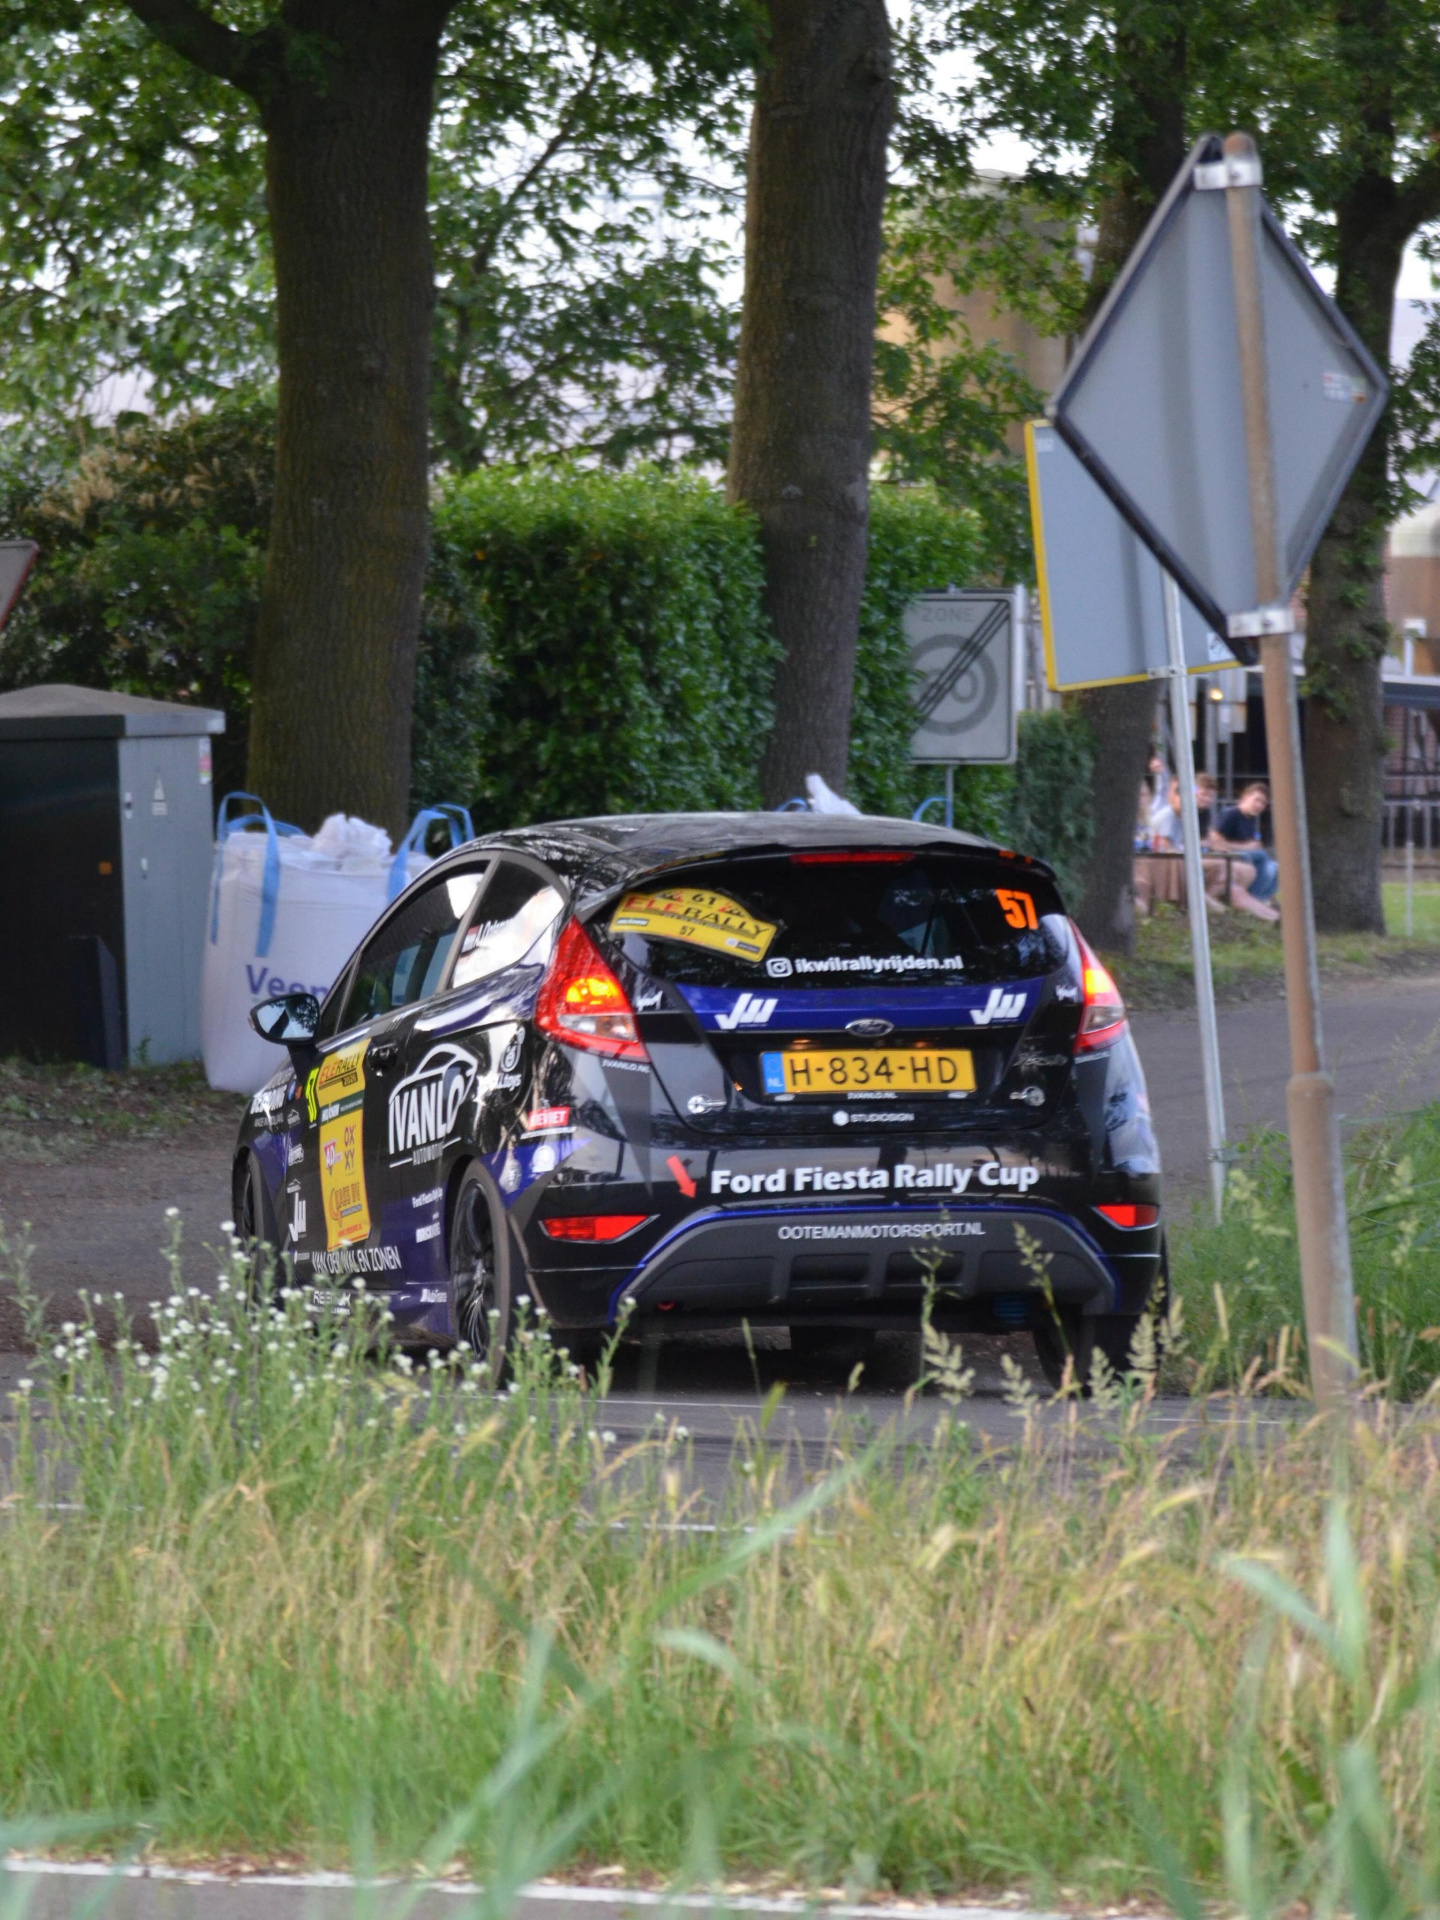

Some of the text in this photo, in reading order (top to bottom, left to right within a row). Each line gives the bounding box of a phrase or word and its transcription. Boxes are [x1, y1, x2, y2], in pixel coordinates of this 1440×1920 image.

[996, 888, 1039, 931] 57
[794, 955, 965, 974] ikwilrallyrijden.nl
[767, 1055, 958, 1088] NL H-834-HD
[388, 1073, 466, 1156] IVANLO
[710, 1161, 1040, 1194] Ford Fiesta Rally Cup
[777, 1222, 987, 1240] OOTEMANMOTORSPORT.NL
